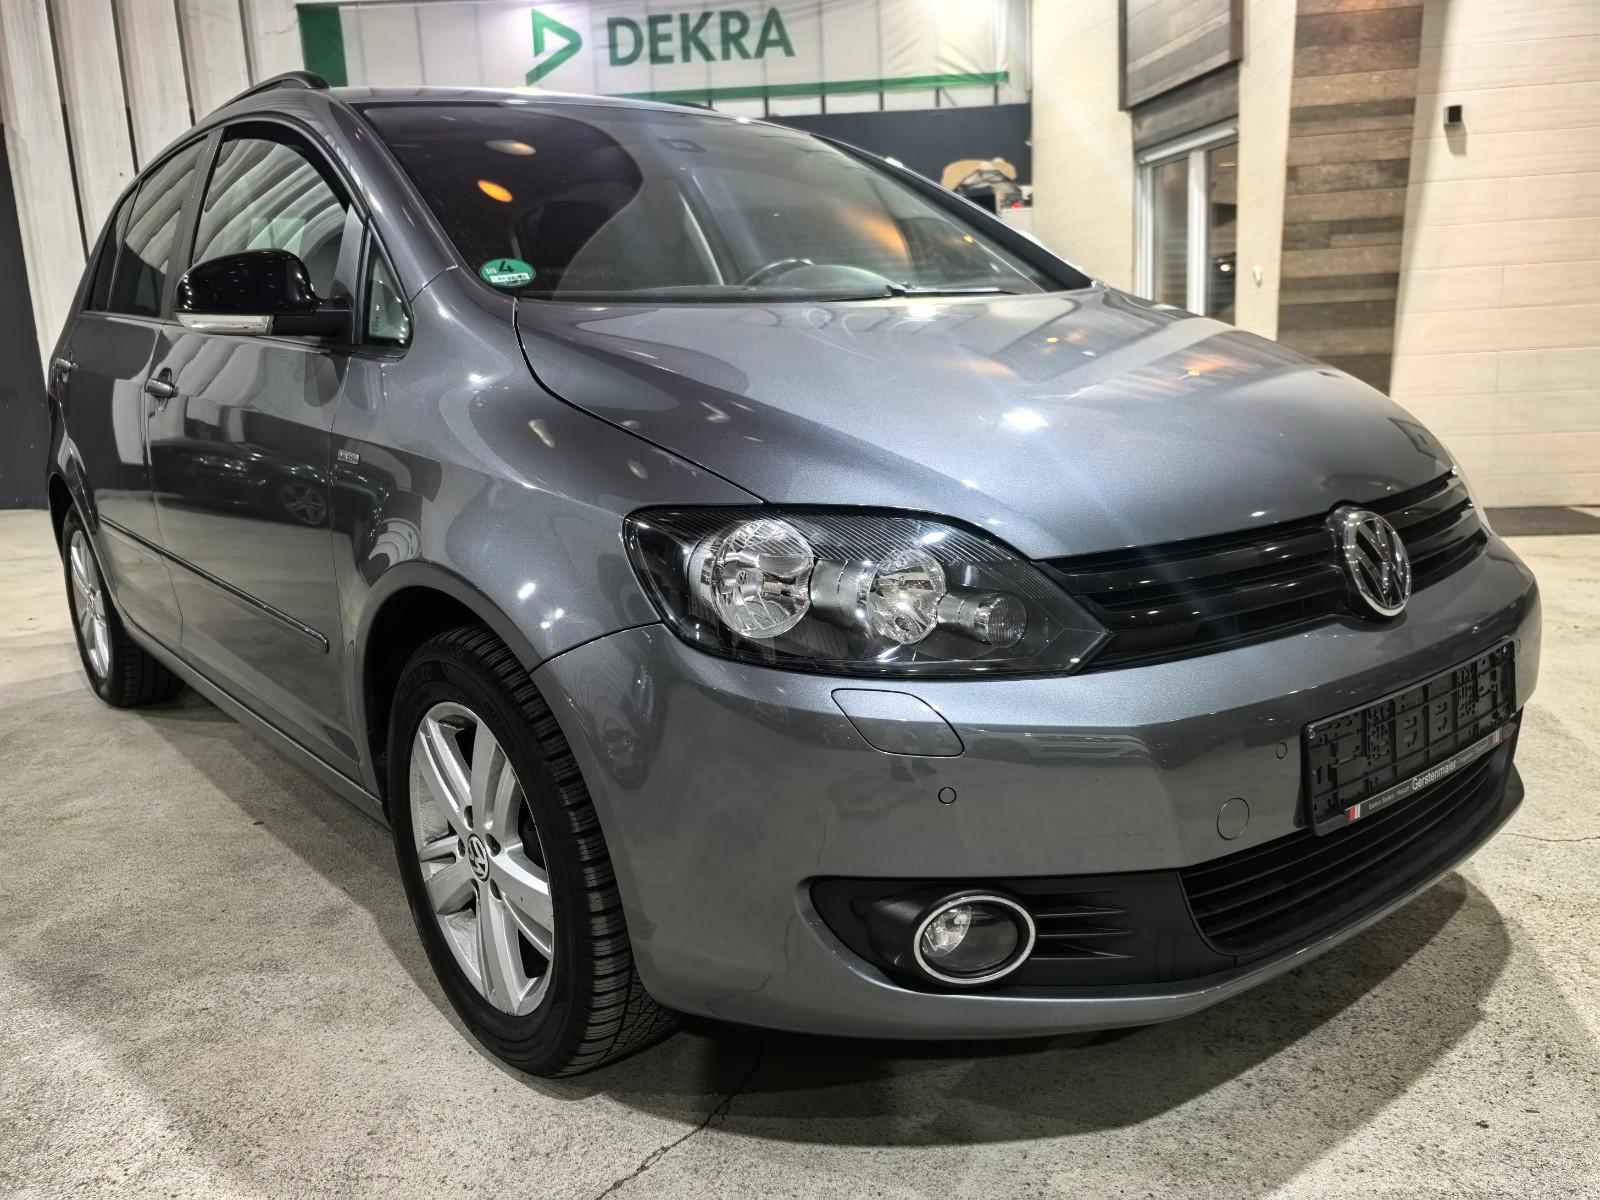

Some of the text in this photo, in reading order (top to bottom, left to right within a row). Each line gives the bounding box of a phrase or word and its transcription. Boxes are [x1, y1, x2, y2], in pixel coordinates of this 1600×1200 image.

[606, 6, 796, 68] DEKRA
[498, 260, 515, 273] 4
[1412, 759, 1457, 790] Gerstenmaier
